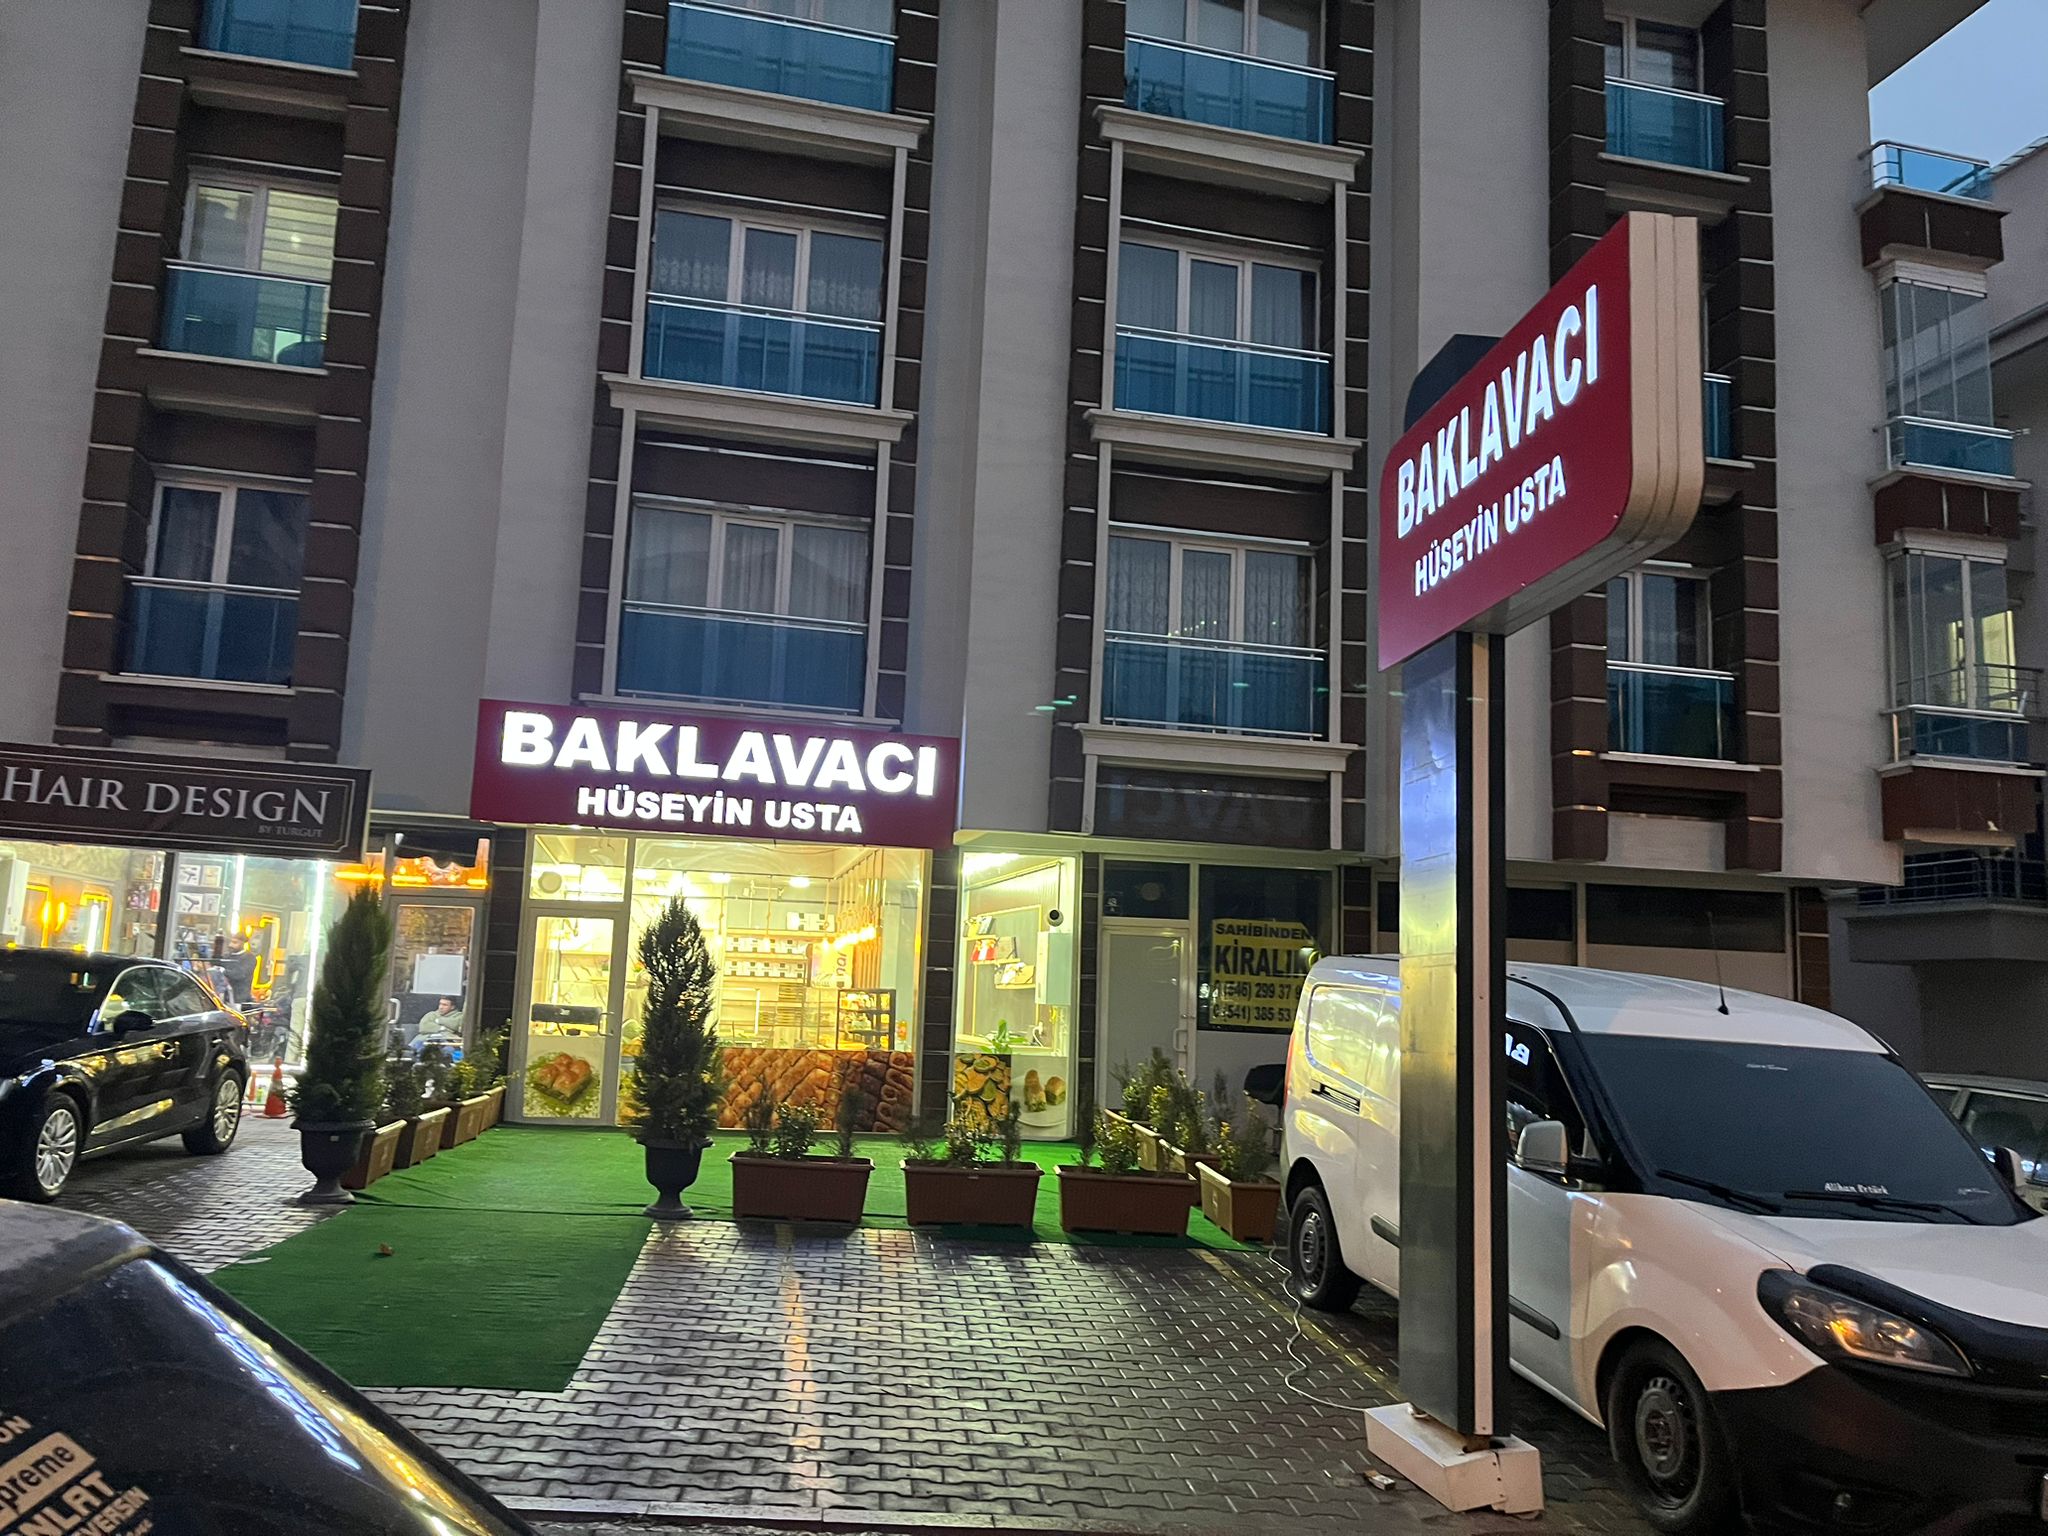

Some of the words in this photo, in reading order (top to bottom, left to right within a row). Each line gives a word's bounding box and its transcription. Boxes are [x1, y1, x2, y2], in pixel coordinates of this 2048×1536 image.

[1398, 284, 1598, 539] BAKLAVACI
[1415, 503, 1499, 597] HÜSEYİN
[1504, 455, 1567, 534] USTA
[501, 710, 937, 798] BAKLAVACI
[1, 766, 129, 811] HAIR
[143, 782, 331, 825] DESIGN
[577, 784, 752, 827] HÜSEYİN
[764, 800, 863, 834] USTA
[275, 826, 323, 838] TURGUT
[0, 1446, 75, 1514] preme
[8, 1470, 115, 1536] NLAT
